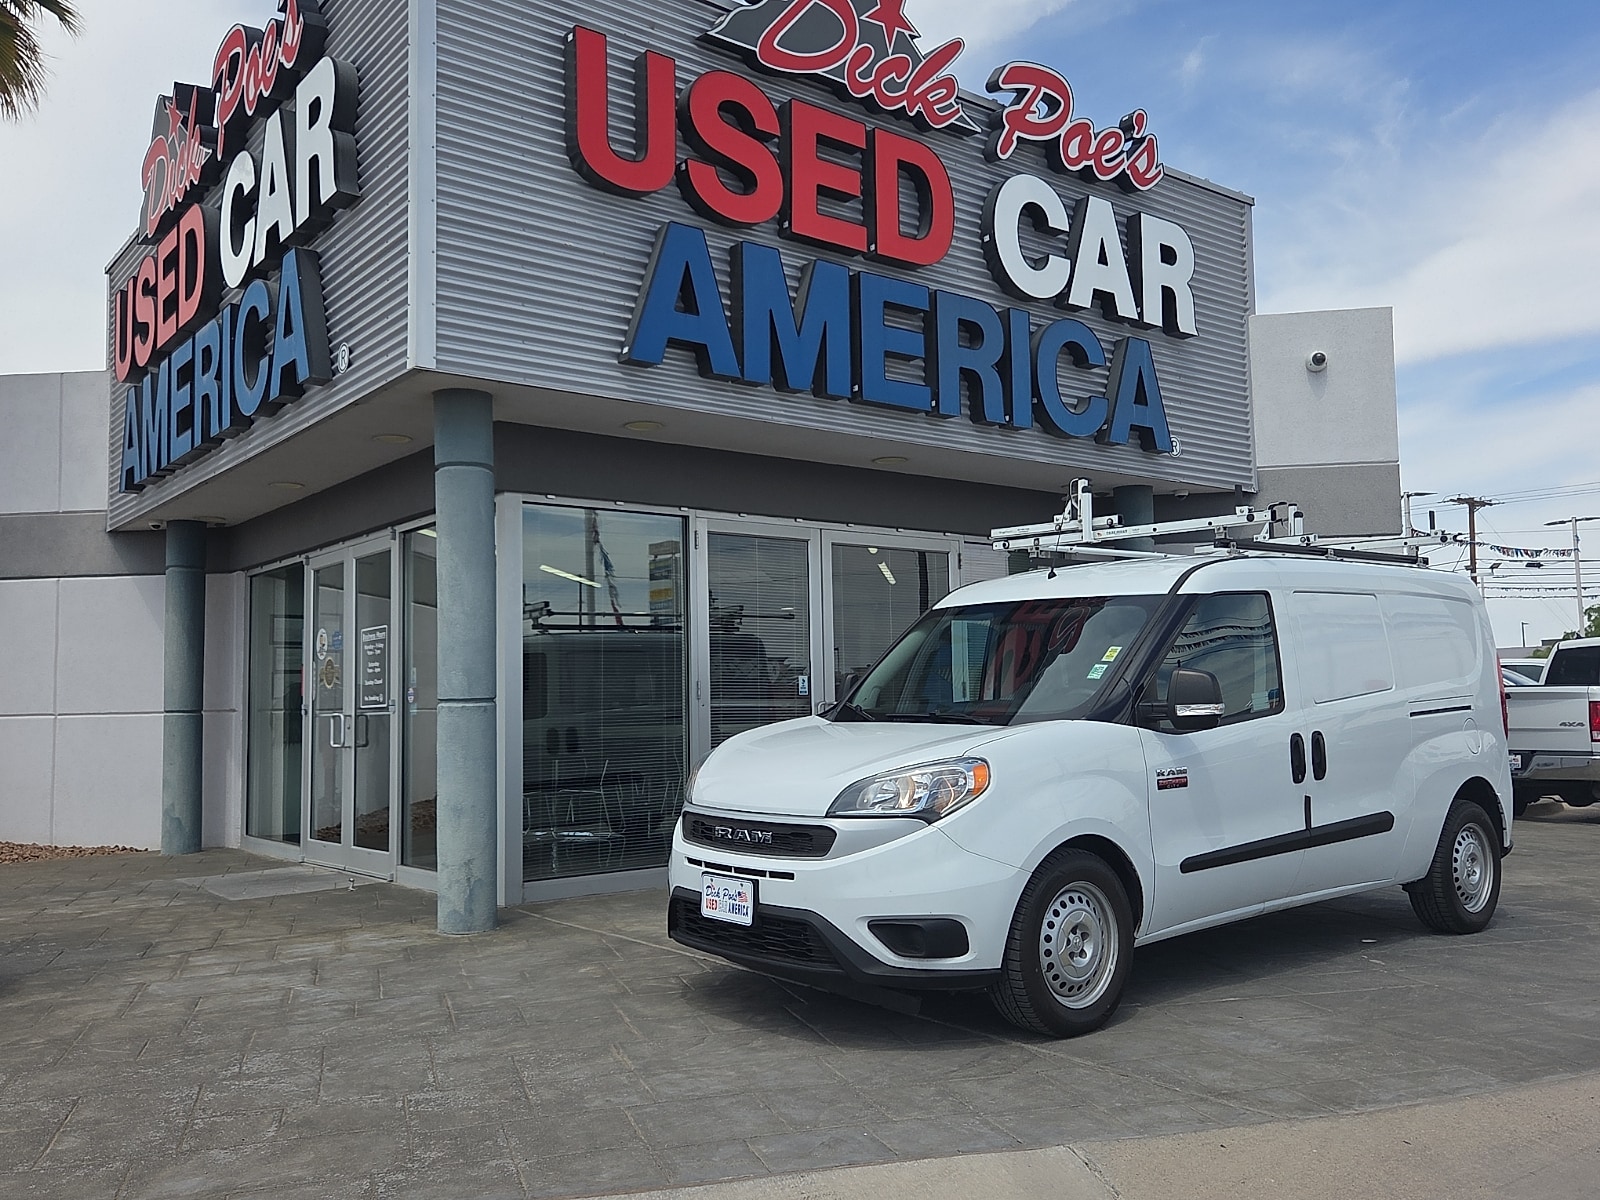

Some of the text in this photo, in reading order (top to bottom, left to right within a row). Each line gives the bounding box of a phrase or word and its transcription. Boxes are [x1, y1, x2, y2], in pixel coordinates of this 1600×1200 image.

[142, 0, 303, 238] Dick Poes
[574, 25, 1198, 336] USED CAR
[757, 0, 1164, 190] Dick Poe's
[114, 56, 338, 383] USED CAR
[120, 248, 310, 492] AMERICA
[627, 221, 1173, 453] AMERICA
[715, 826, 773, 844] RAM
[1156, 767, 1188, 777] RAM
[728, 902, 749, 918] AMERICA
